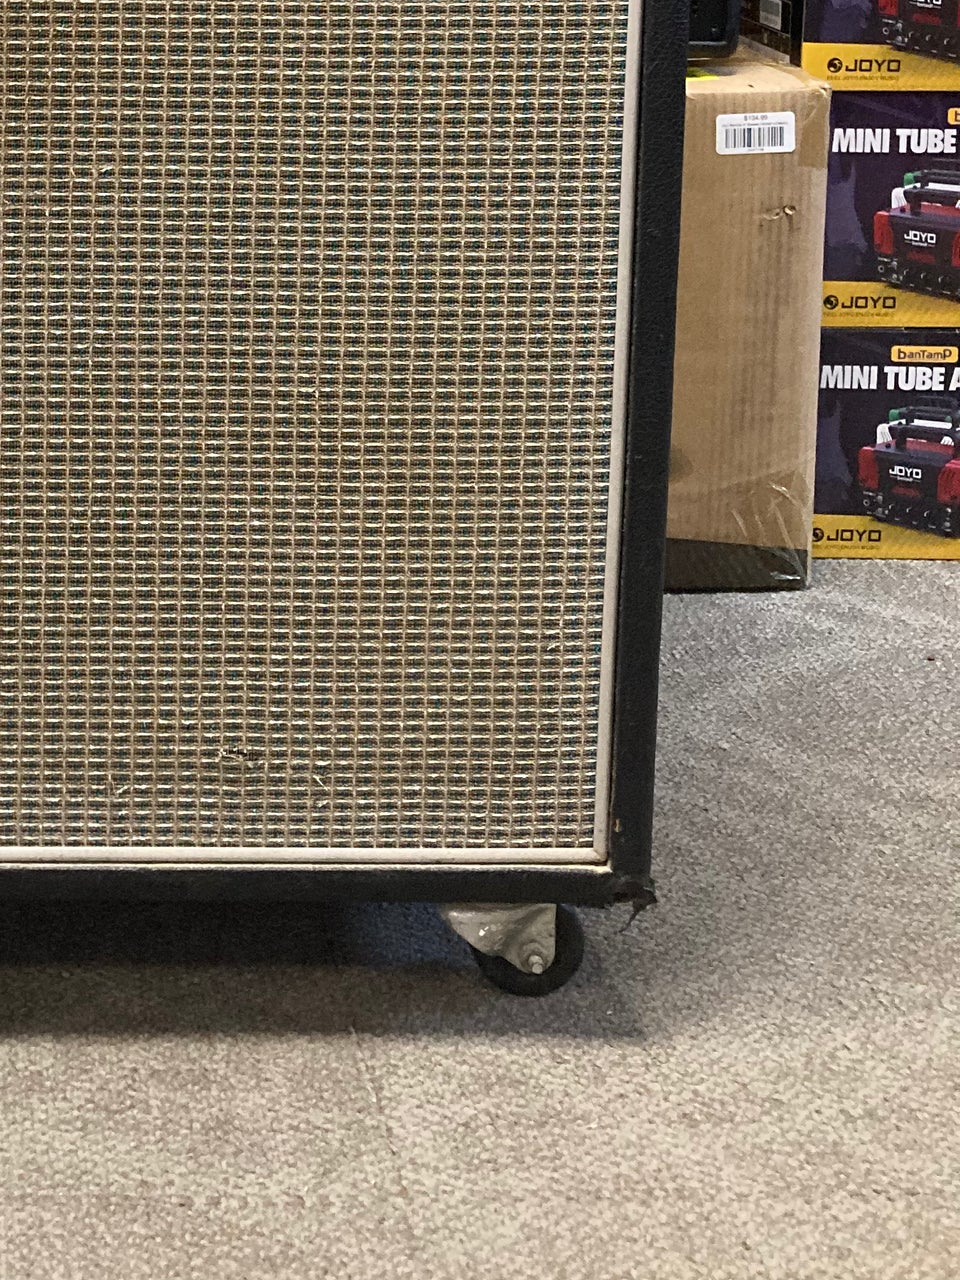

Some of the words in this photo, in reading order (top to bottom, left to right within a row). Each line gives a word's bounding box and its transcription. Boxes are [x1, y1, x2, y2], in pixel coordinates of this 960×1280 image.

[844, 59, 901, 73] JOYO
[831, 128, 890, 154] MINI
[896, 128, 957, 154] TUBE
[904, 230, 937, 244] JOYO
[841, 296, 897, 310] JOYO
[820, 365, 878, 390] MINI
[884, 366, 946, 392] TUBE
[889, 465, 922, 479] JOYO
[827, 529, 882, 543] JOYO
